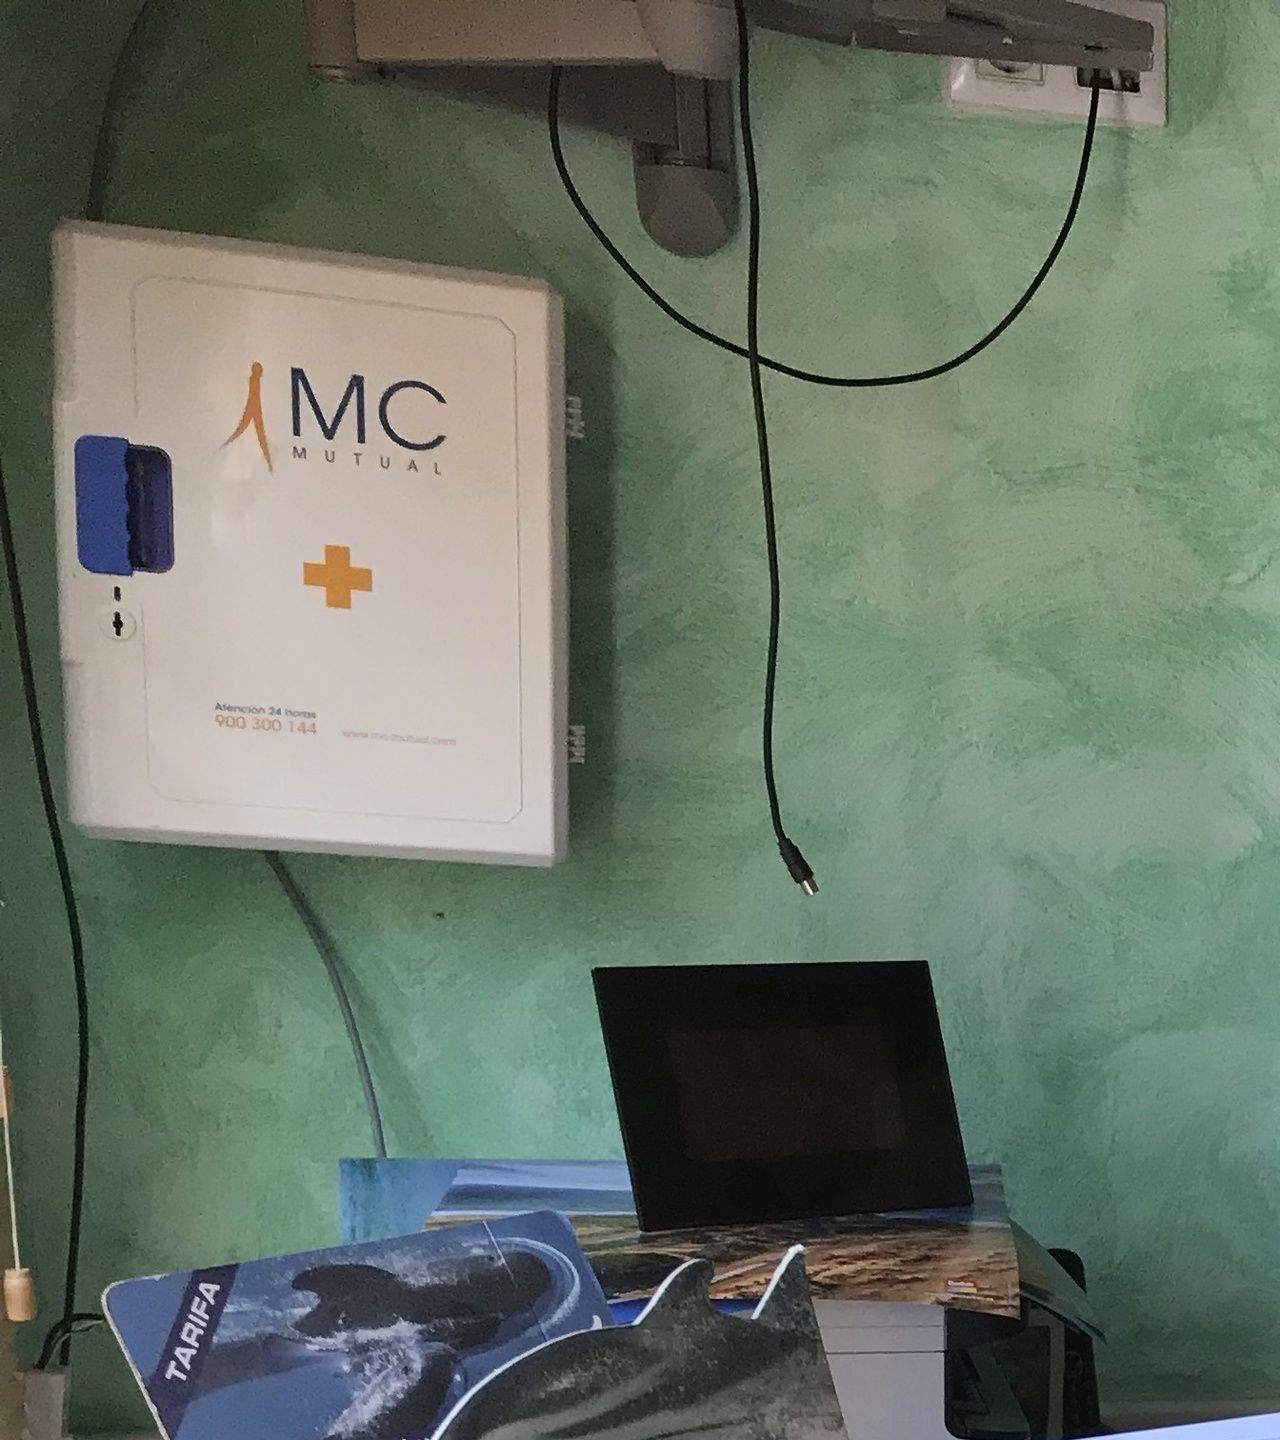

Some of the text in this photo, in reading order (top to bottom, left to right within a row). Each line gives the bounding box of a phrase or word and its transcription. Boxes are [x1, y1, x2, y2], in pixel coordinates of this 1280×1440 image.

[290, 366, 448, 451] MC
[292, 446, 443, 476] MUTUAL
[215, 703, 266, 715] Atención
[268, 708, 281, 716] 24
[215, 715, 316, 734] 900 300 144
[164, 1280, 221, 1383] TARIFA
